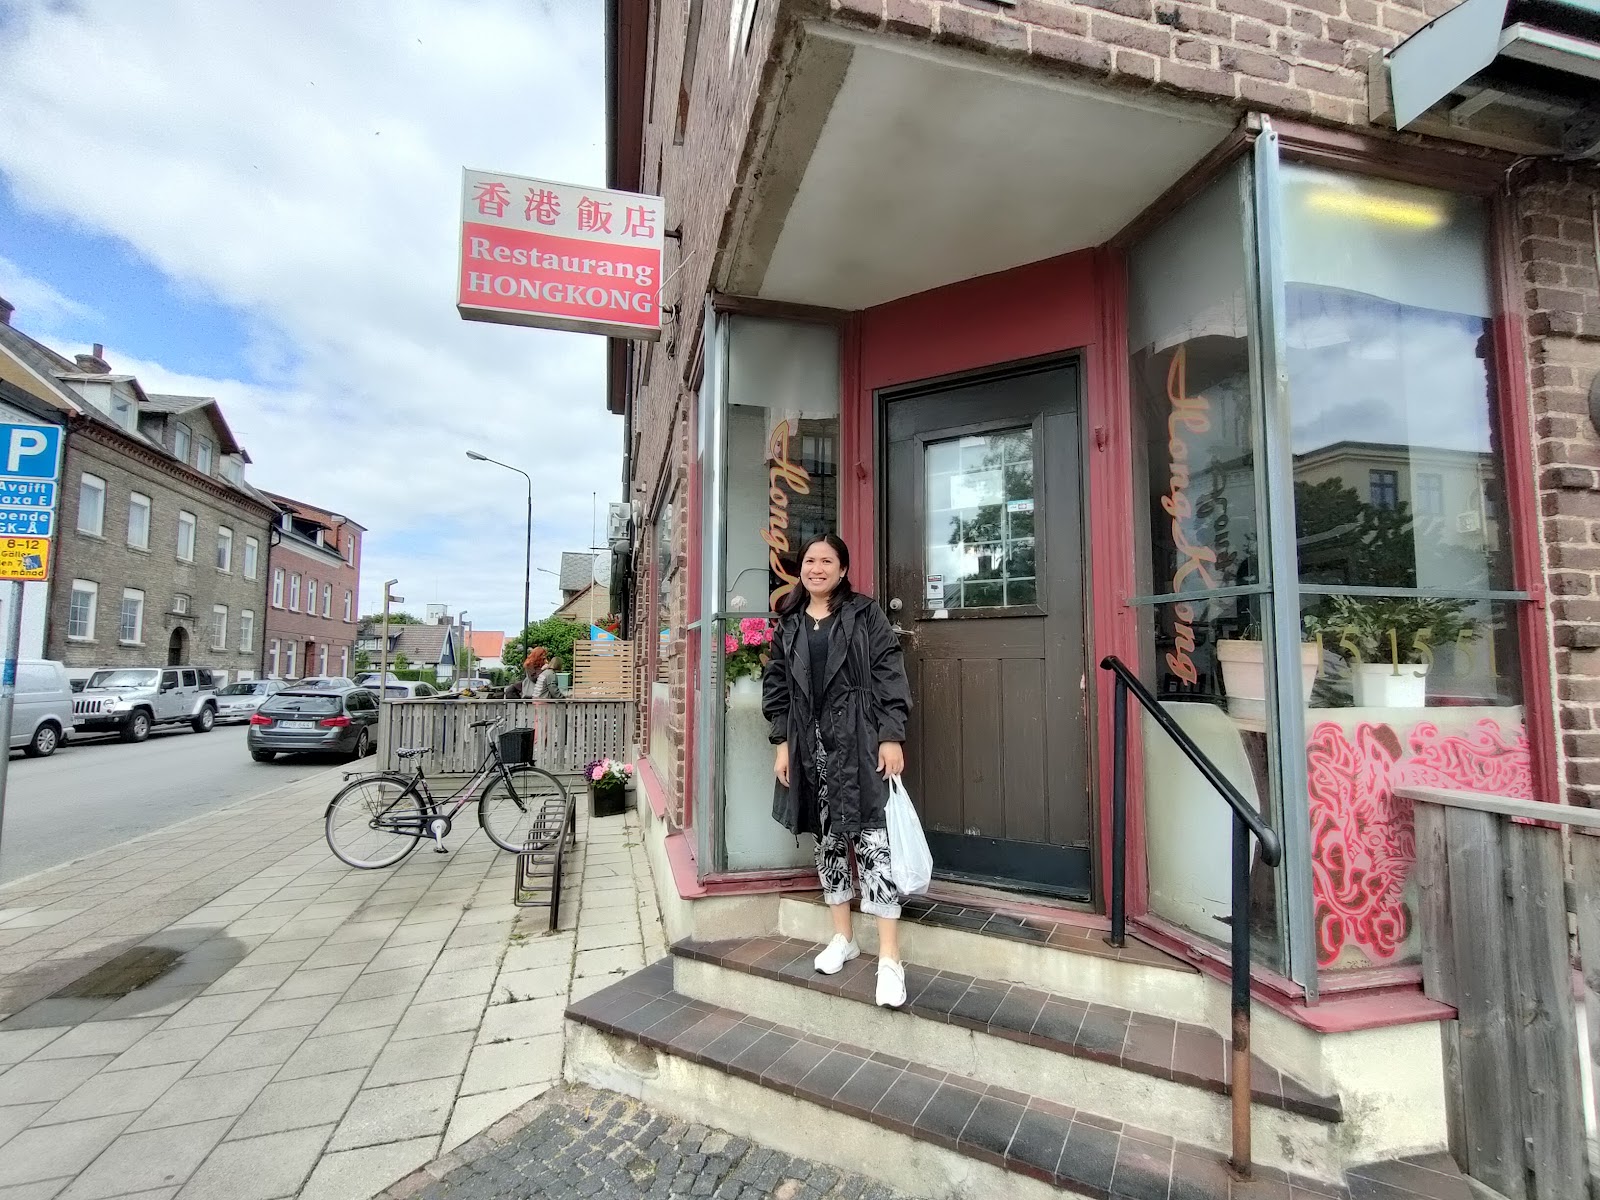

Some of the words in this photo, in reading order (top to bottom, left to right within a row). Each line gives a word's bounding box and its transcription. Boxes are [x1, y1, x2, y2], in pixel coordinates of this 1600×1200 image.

[472, 181, 656, 239] 香港飯店
[469, 236, 654, 287] Restaurang
[467, 271, 652, 313] HONGKONG
[7, 429, 47, 472] P
[0, 482, 46, 494] Avgift
[0, 495, 32, 505] axa
[39, 495, 47, 506] E
[760, 419, 811, 553] Hong
[7, 539, 40, 549] 8-12
[11, 568, 44, 577] månad
